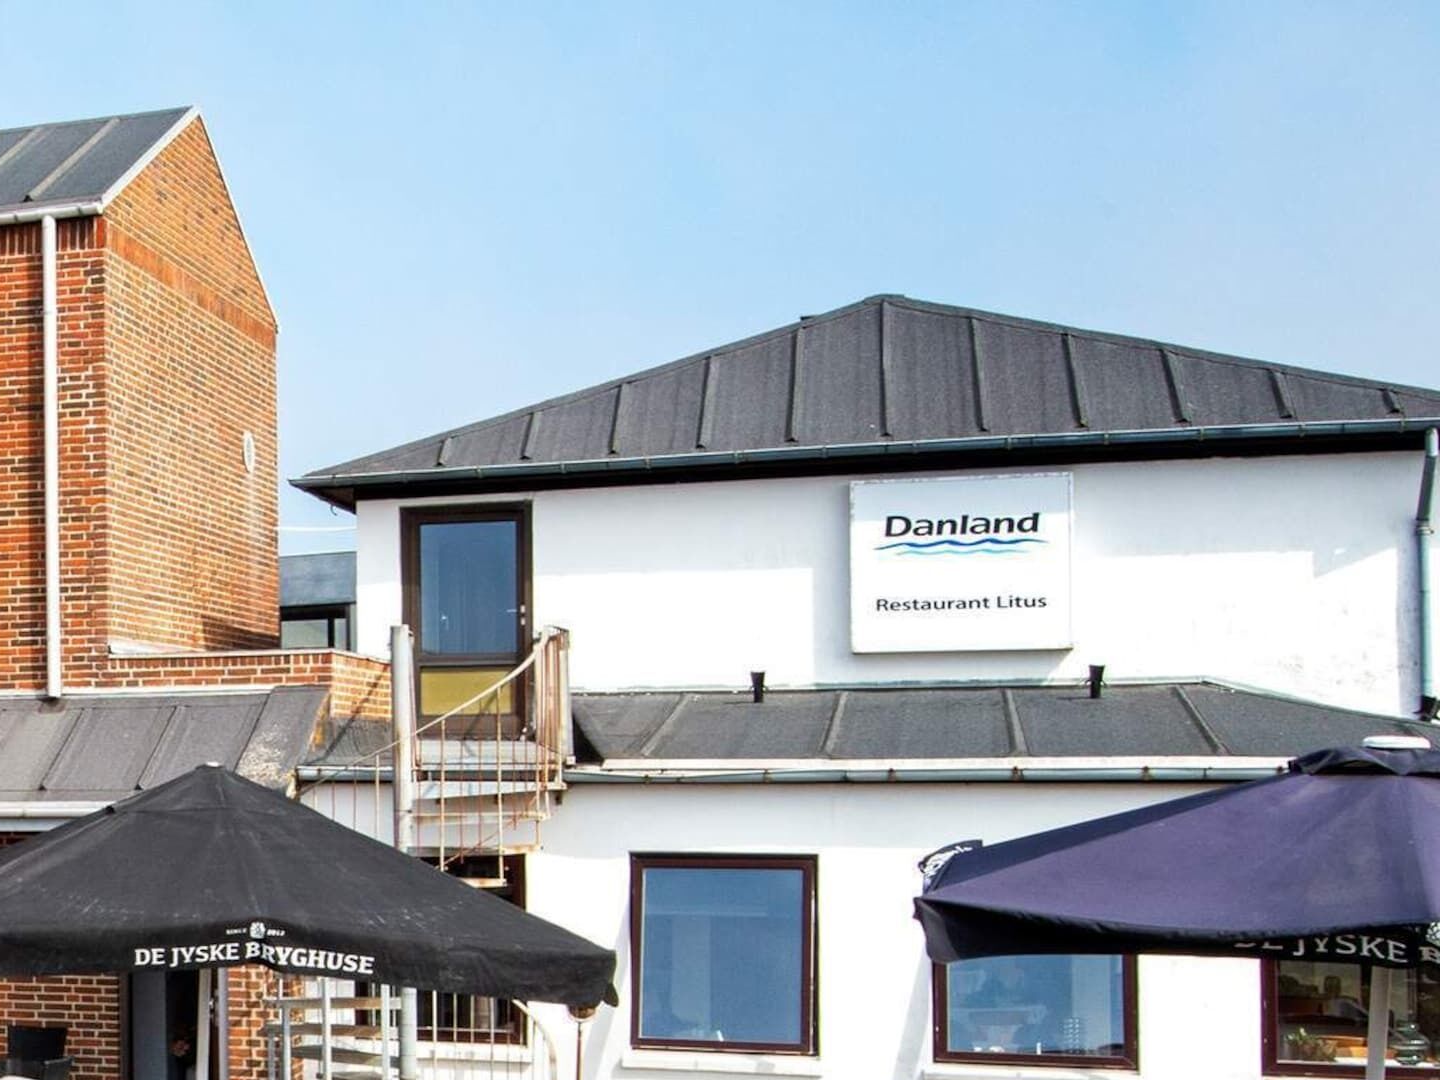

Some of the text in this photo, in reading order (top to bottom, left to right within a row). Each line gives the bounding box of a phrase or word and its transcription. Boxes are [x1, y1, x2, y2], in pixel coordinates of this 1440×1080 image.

[884, 511, 1042, 538] Danland
[875, 595, 1047, 612] Restaurant Litus
[134, 941, 376, 975] DE JYSKE BRYGHUSE
[1293, 934, 1409, 964] JYSKE
